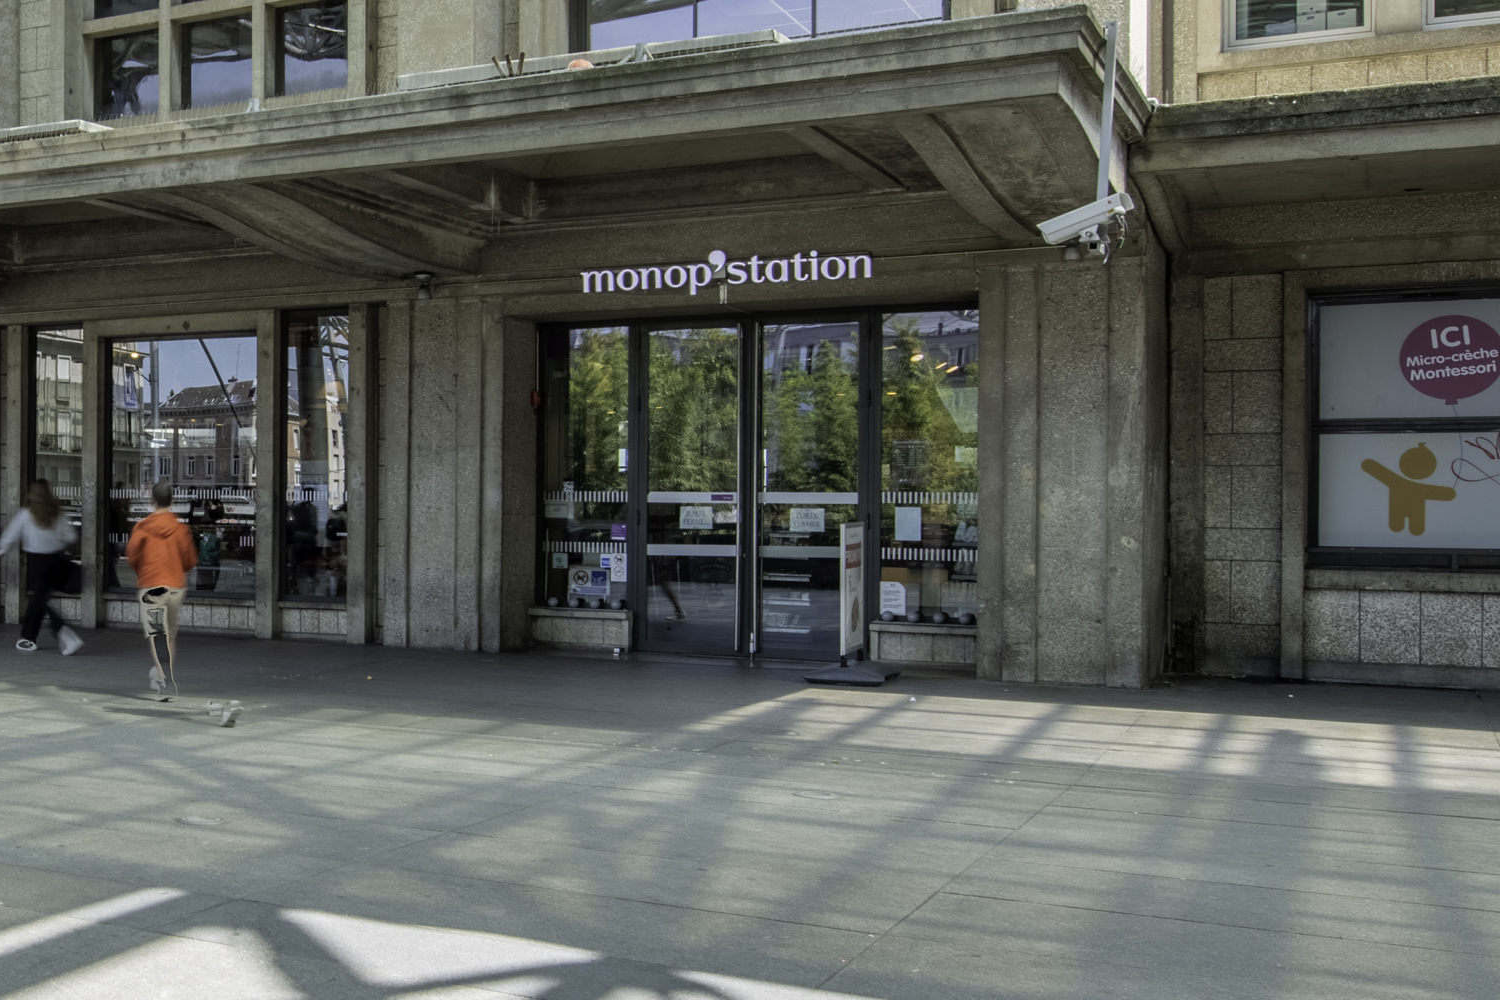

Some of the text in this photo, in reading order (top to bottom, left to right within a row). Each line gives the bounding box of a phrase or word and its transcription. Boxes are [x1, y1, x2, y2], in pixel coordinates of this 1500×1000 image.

[580, 250, 872, 295] monop'station
[1430, 325, 1471, 349] ICI
[1406, 348, 1499, 367] Micro-crèche
[1410, 360, 1497, 381] Montessori
